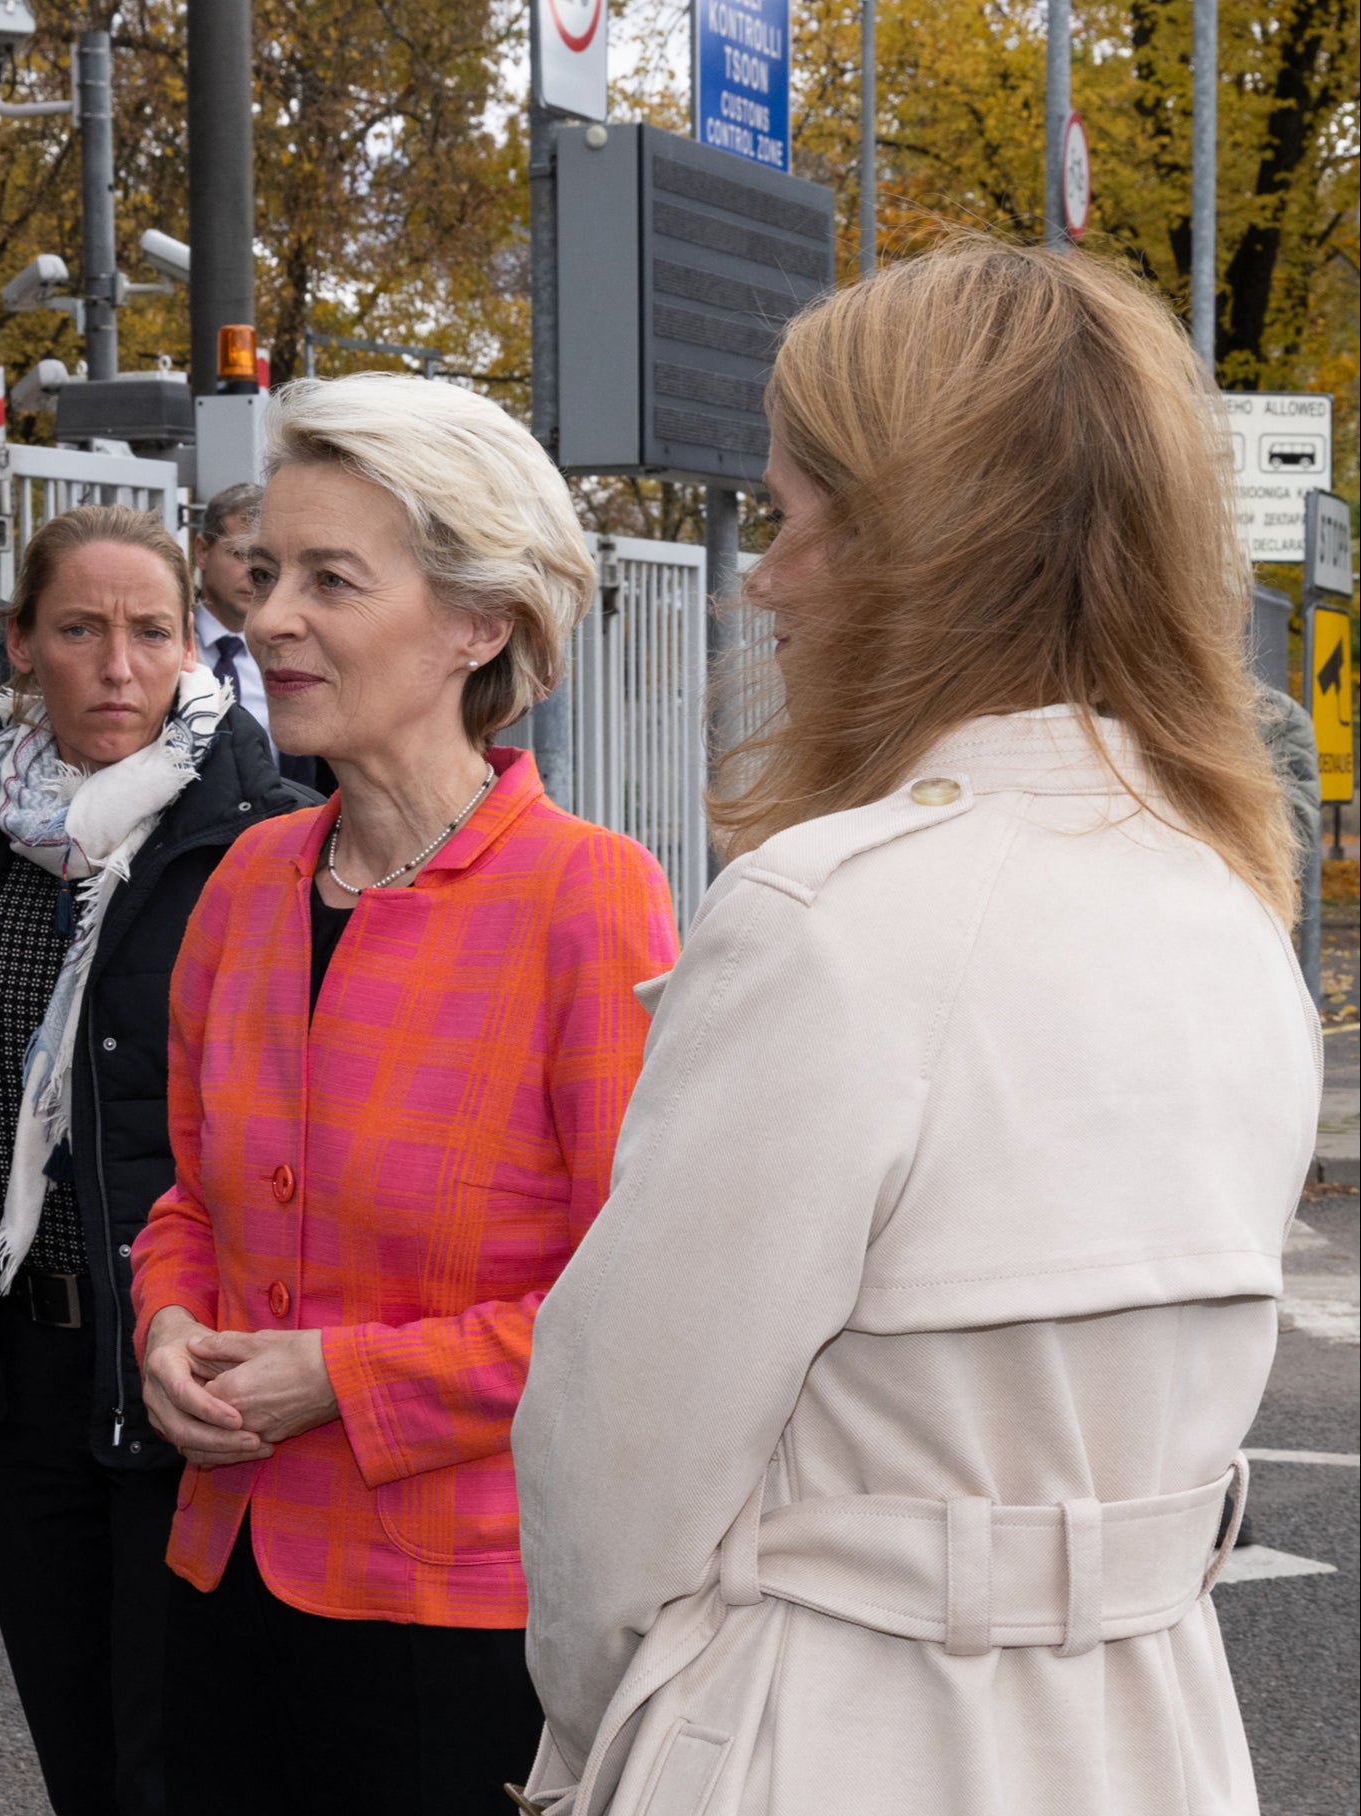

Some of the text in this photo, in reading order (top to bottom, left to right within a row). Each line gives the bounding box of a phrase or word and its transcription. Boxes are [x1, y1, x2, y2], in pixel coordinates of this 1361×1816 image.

[709, 1, 782, 59] KONTROLLI
[724, 45, 769, 95] TSOON
[721, 90, 770, 132] CUSTOMS
[706, 117, 783, 168] CONTROL ZONE
[1264, 400, 1326, 417] ALLOWED
[1253, 539, 1305, 552] DECLARA
